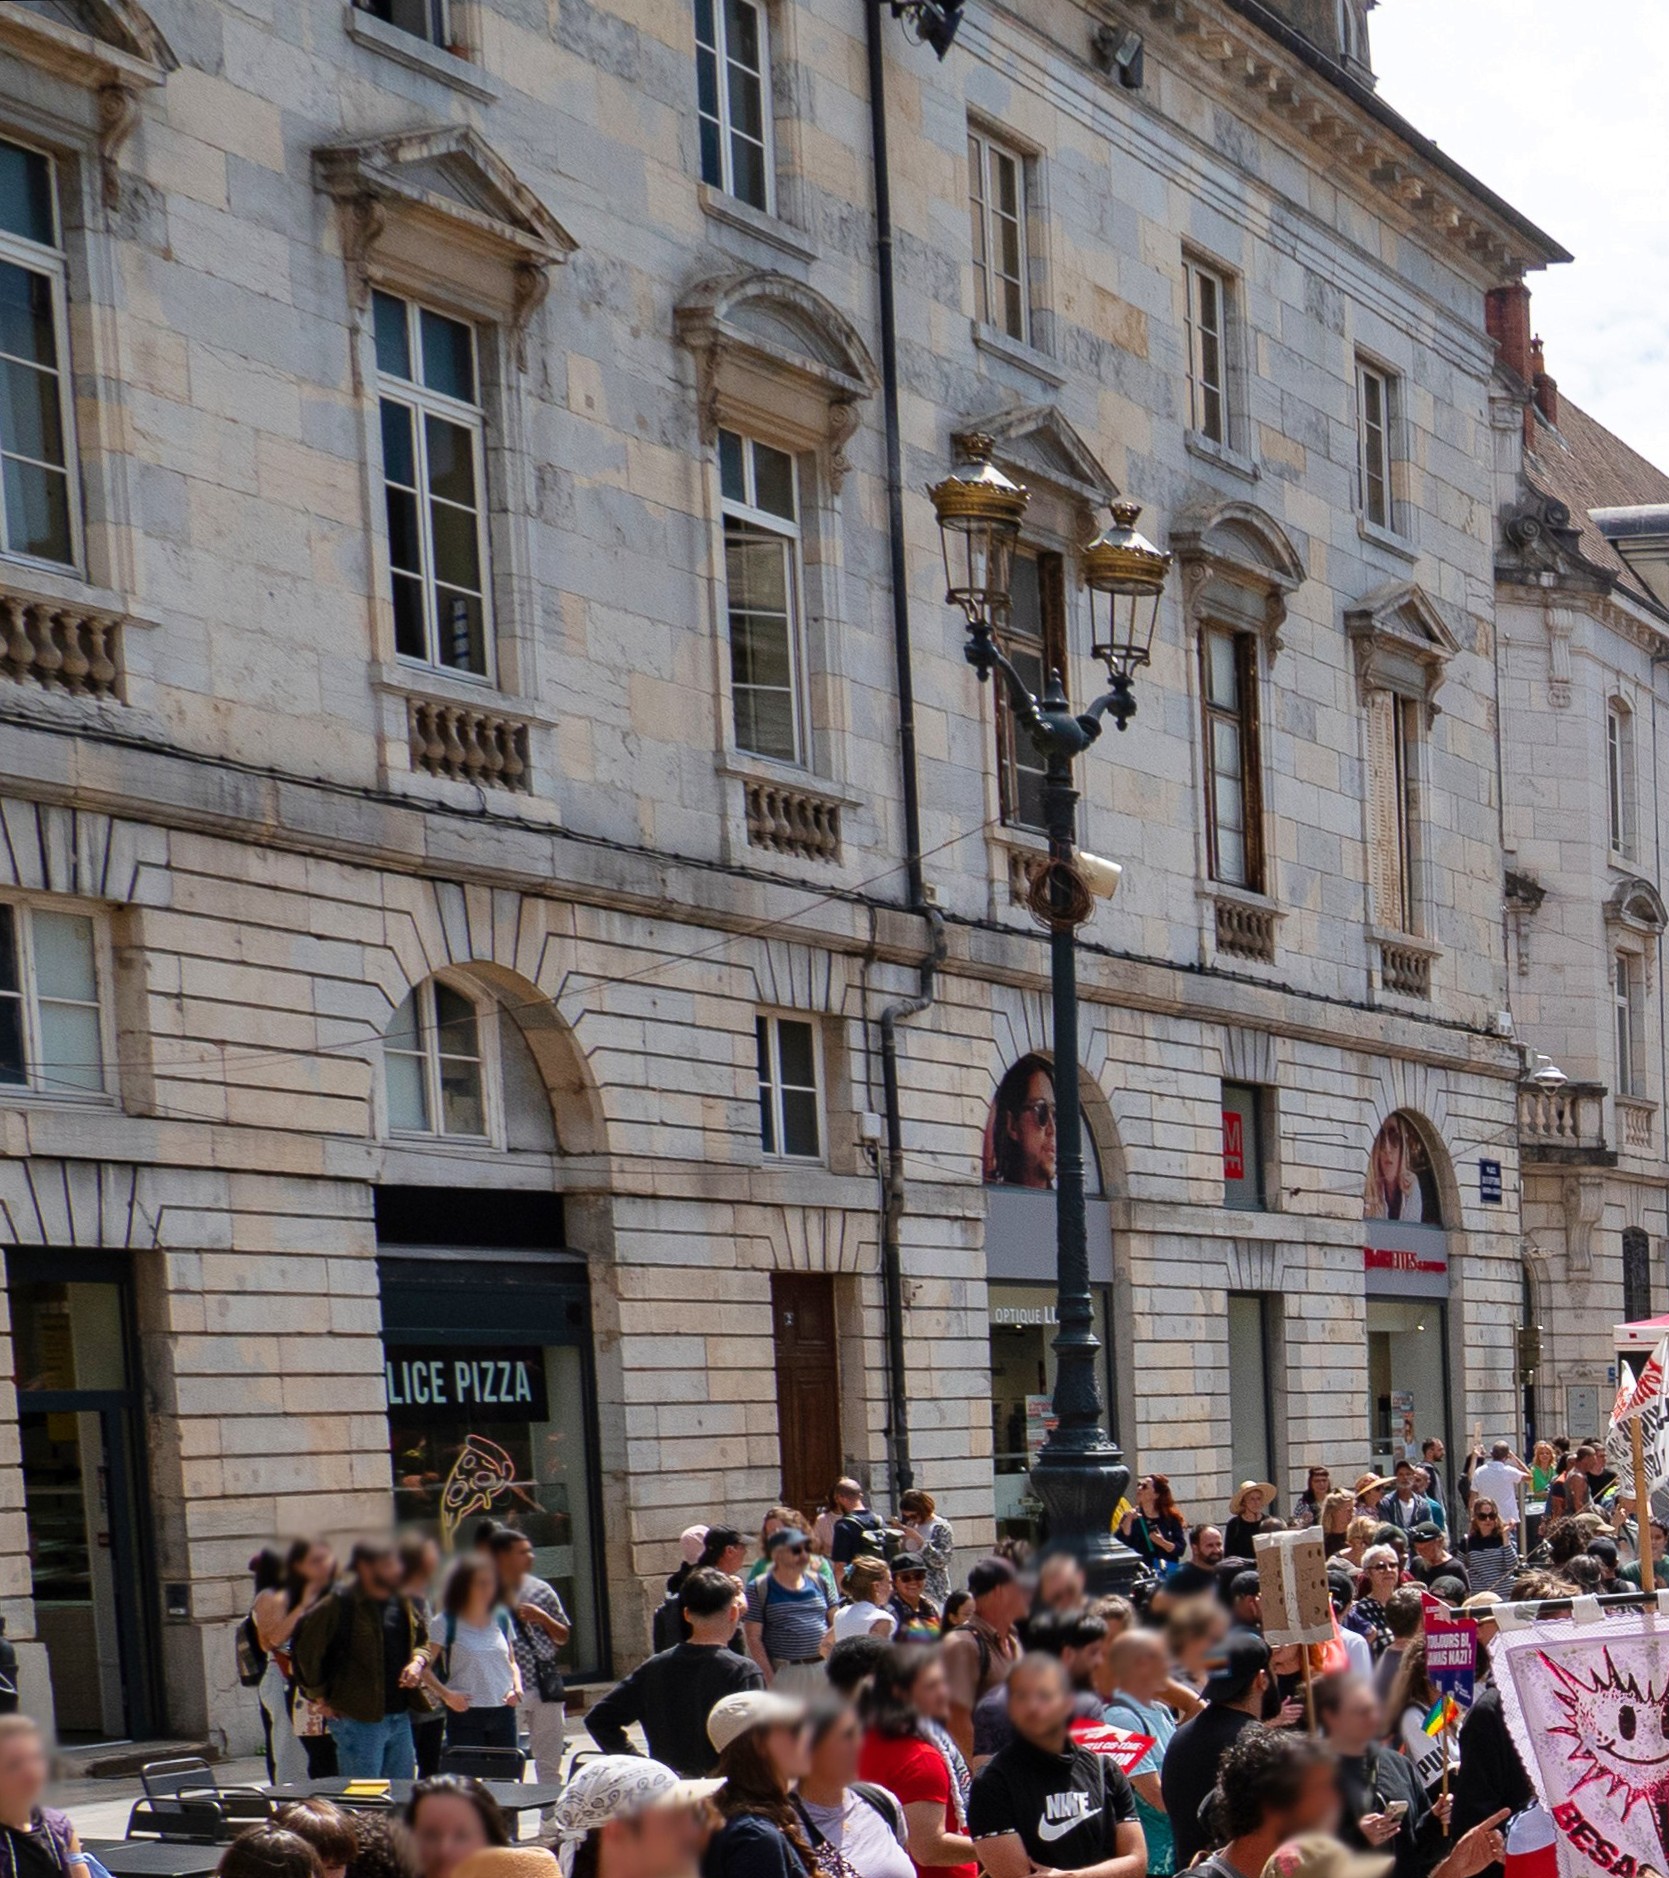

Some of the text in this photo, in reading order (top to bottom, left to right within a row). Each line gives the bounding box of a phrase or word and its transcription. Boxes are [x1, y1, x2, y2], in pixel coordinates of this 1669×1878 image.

[995, 1305, 1060, 1325] OPTIQUE LI
[386, 1360, 533, 1405] LICE PIZZA
[1426, 1632, 1472, 1650] TOUJOURS BI,
[1448, 1649, 1469, 1666] NAZI
[1416, 1746, 1444, 1782] PU
